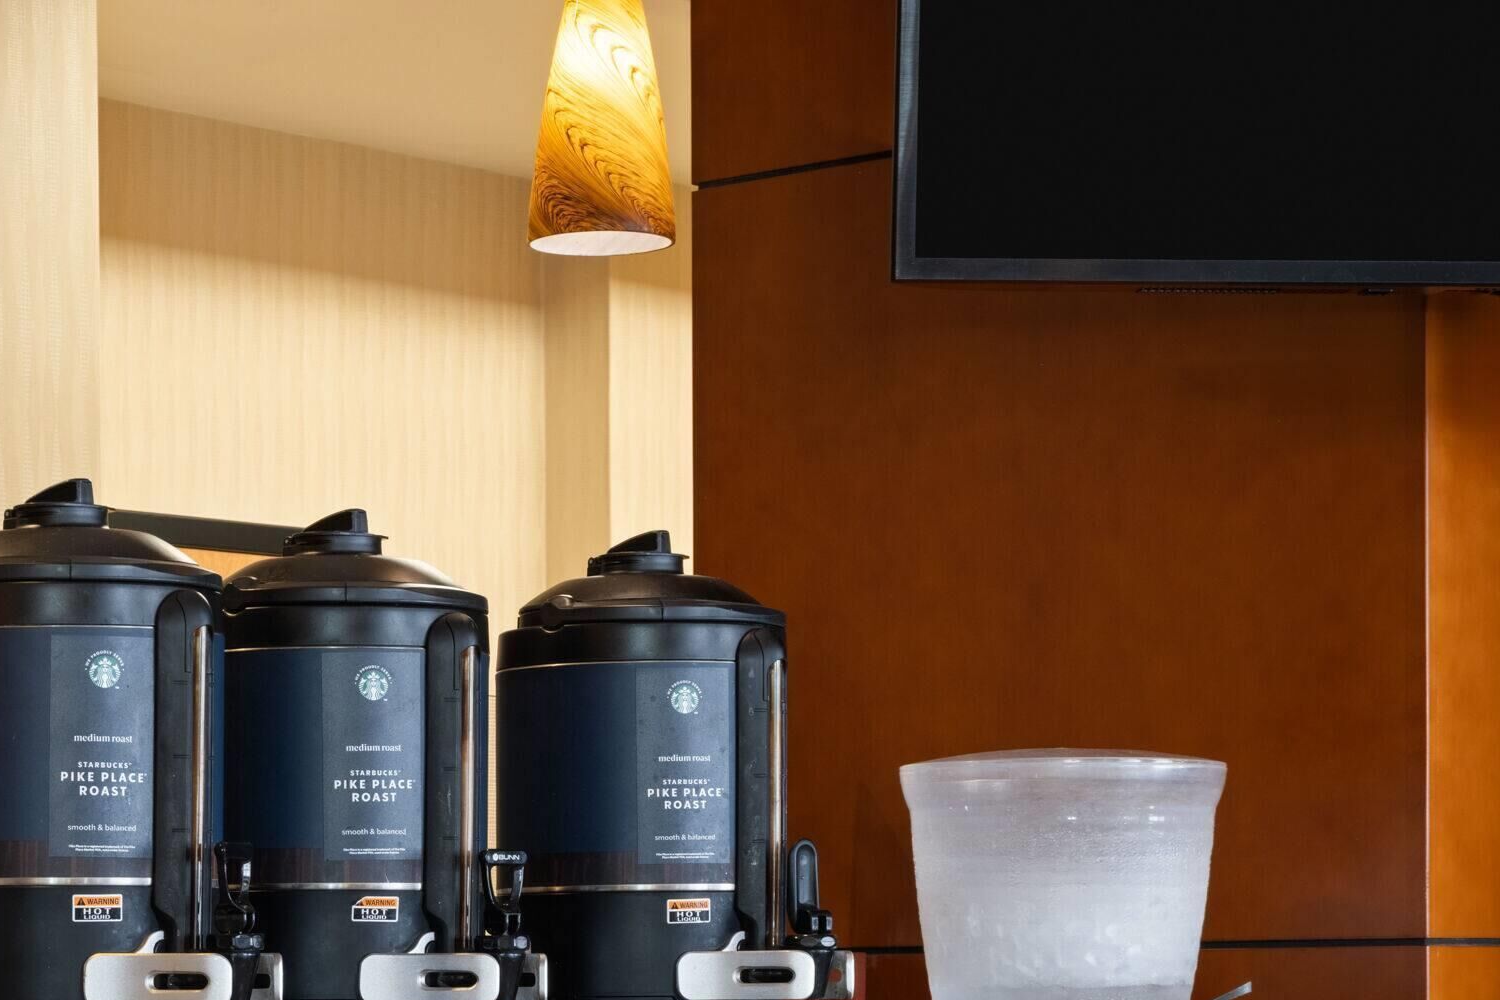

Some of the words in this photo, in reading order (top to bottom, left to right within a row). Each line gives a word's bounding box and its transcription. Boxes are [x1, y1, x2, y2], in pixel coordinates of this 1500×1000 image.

[73, 733, 110, 743] medium
[111, 735, 133, 743] roast
[346, 743, 380, 752] medium
[381, 744, 402, 752] roast
[658, 754, 691, 762] medium
[78, 761, 129, 769] STARBUCKS
[60, 772, 95, 782] PIKE
[101, 772, 144, 783] PLACE
[334, 780, 366, 789] PIKE
[372, 779, 413, 789] PLACE
[79, 785, 127, 796] ROAST
[647, 788, 678, 797] PIKE
[683, 788, 722, 797] PLACE
[351, 793, 397, 802] ROAST
[664, 800, 707, 809] ROAST
[104, 824, 137, 832] balanced
[341, 828, 369, 836] smooth
[377, 828, 407, 836] balanced
